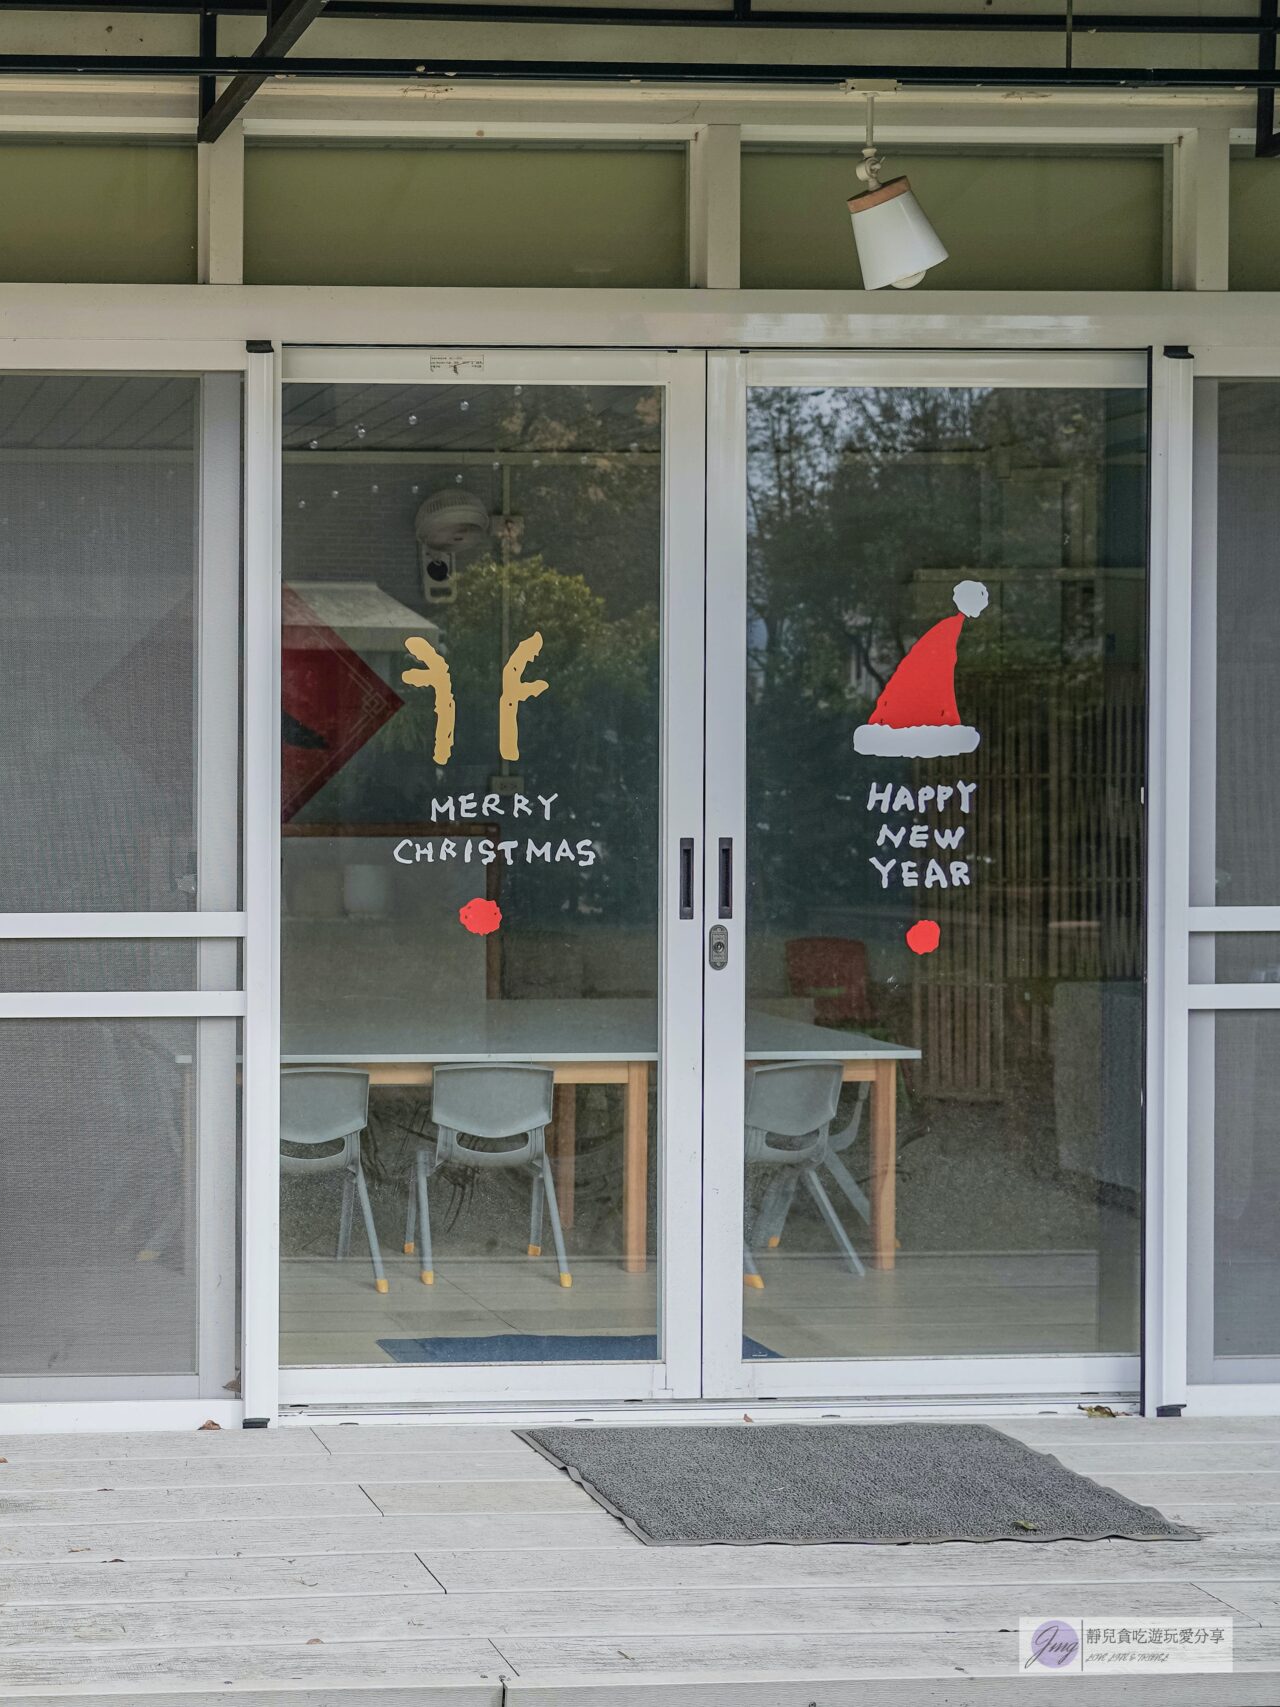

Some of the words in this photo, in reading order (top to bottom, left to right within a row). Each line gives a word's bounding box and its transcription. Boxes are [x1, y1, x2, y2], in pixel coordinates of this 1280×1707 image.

[430, 792, 559, 822] MERRY
[866, 780, 977, 814] HAPPY
[876, 823, 965, 850] NEW
[393, 838, 596, 867] CHRISTMAS
[868, 856, 971, 888] YEAR
